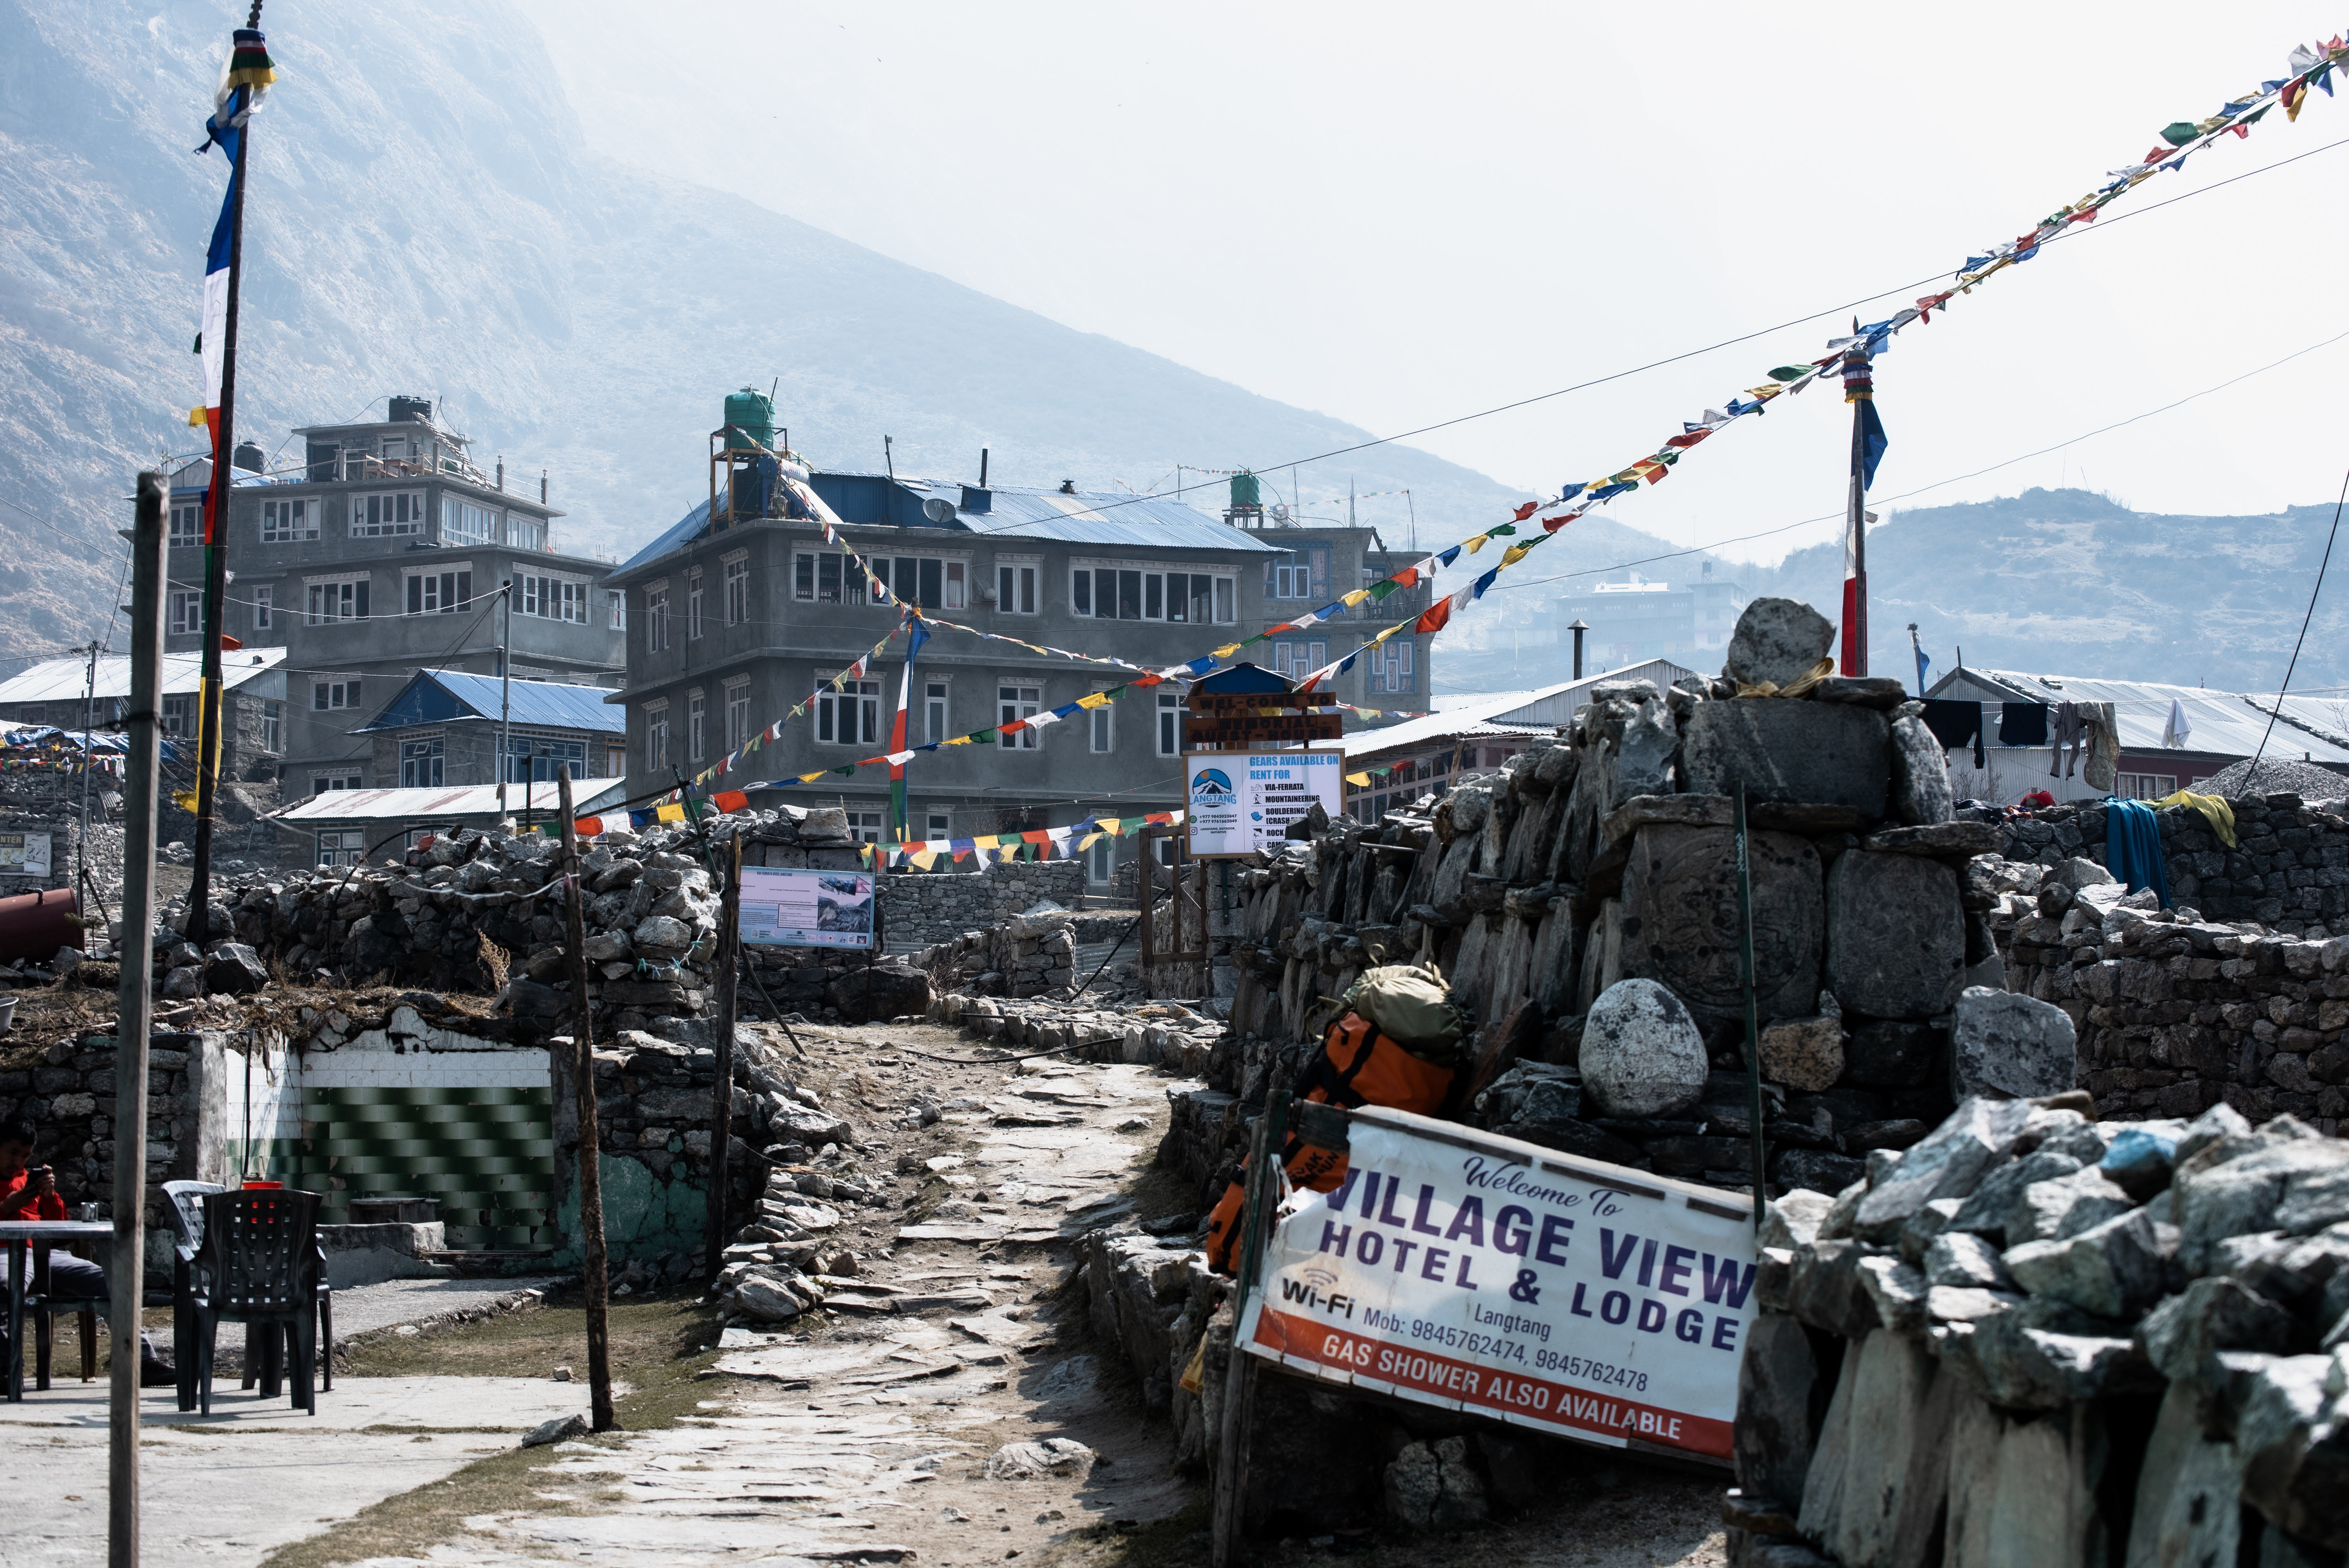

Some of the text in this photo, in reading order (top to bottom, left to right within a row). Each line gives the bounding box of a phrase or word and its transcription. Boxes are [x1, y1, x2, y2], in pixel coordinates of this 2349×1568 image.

[1199, 695, 1330, 709] WEL-COME TO
[1219, 717, 1315, 730] MEMORIAL
[1249, 755, 1338, 766] GEARS AVAILABLE ON
[1250, 770, 1290, 780] RENT FOR
[1189, 794, 1237, 805] LANGTANG
[1265, 795, 1320, 803] MOUNTAINEERING
[1463, 1156, 1631, 1217] Welcome To
[1326, 1167, 1757, 1310] VILLAGE VIEW
[1283, 1277, 1356, 1319] Wi-Fi
[1319, 1219, 1739, 1352] HOTEL & LODGE
[1474, 1303, 1551, 1342] Langtang
[1363, 1307, 1648, 1392] Mob: 9845762474, 9845762478
[1322, 1334, 1682, 1440] GAS SHOWER ALSO AVAILABLE
